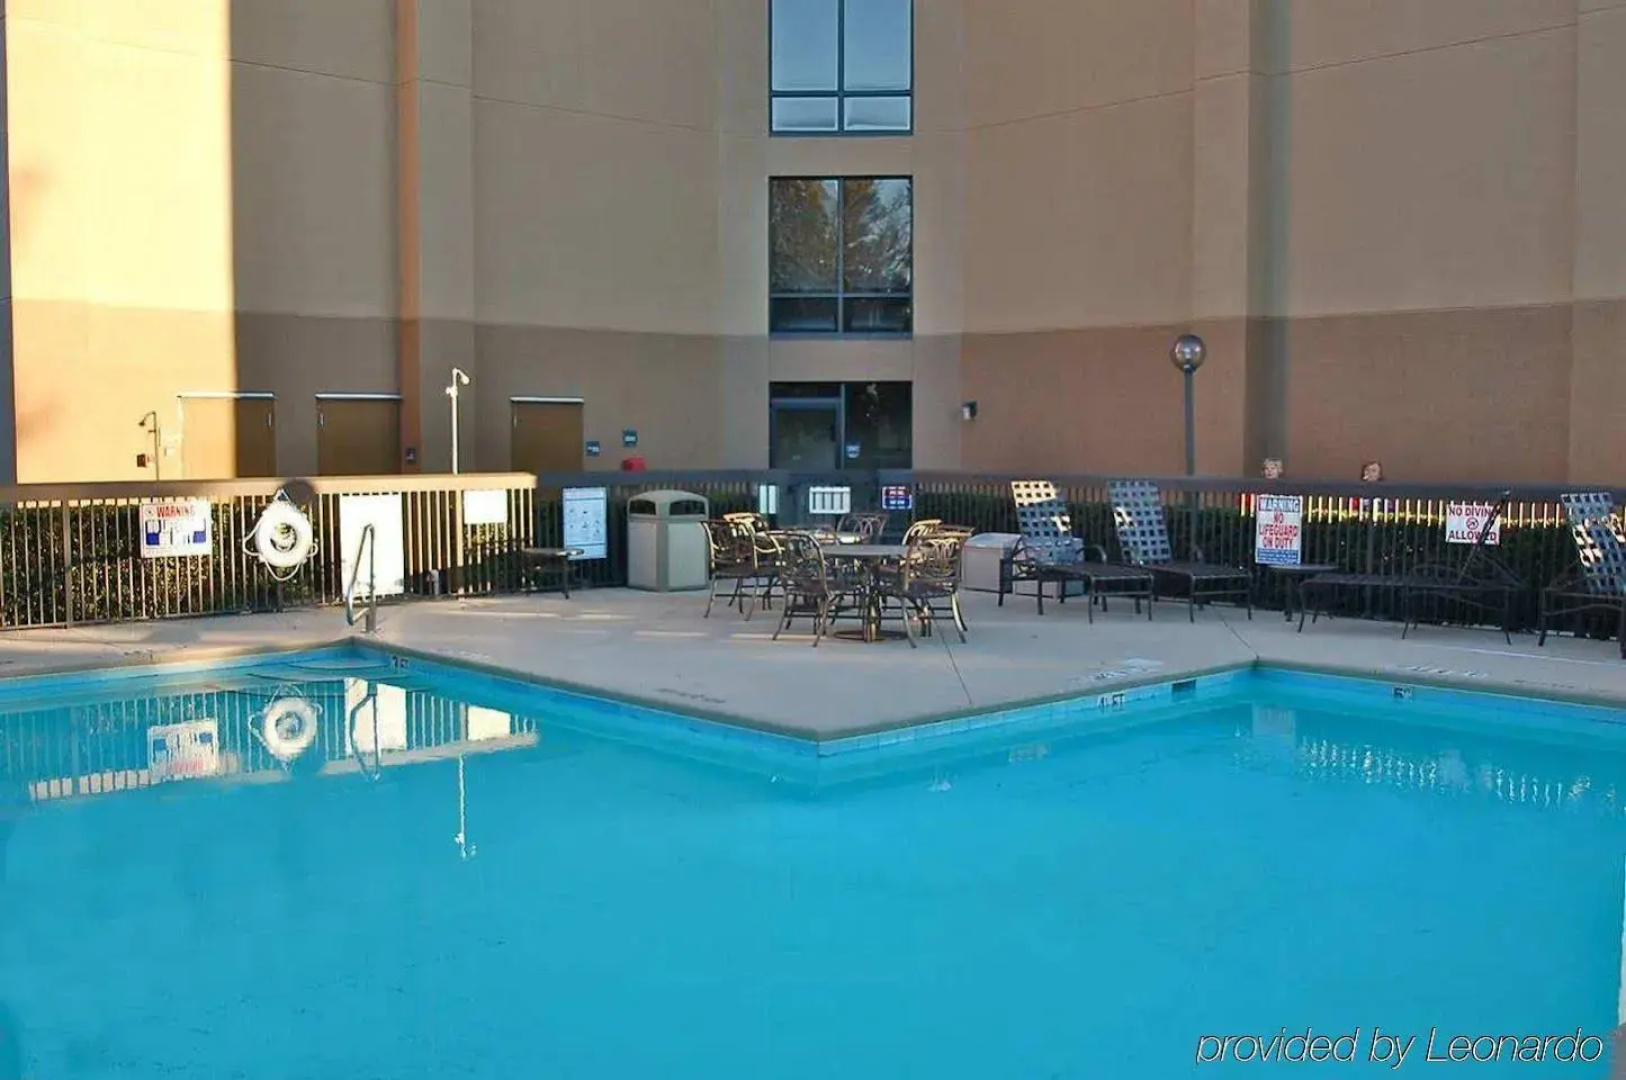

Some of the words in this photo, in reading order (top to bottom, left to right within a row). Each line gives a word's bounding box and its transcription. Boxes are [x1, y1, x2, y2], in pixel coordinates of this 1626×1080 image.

[1260, 499, 1299, 512] WARNING
[157, 506, 195, 518] WARNING
[1449, 507, 1462, 516] NO
[1465, 507, 1494, 517] DIVIN
[1274, 513, 1284, 524] NO
[1260, 524, 1297, 537] LIFEGUARD
[1449, 531, 1496, 541] ALLOWD
[1263, 536, 1273, 549] ON
[1275, 537, 1293, 549] DUTY
